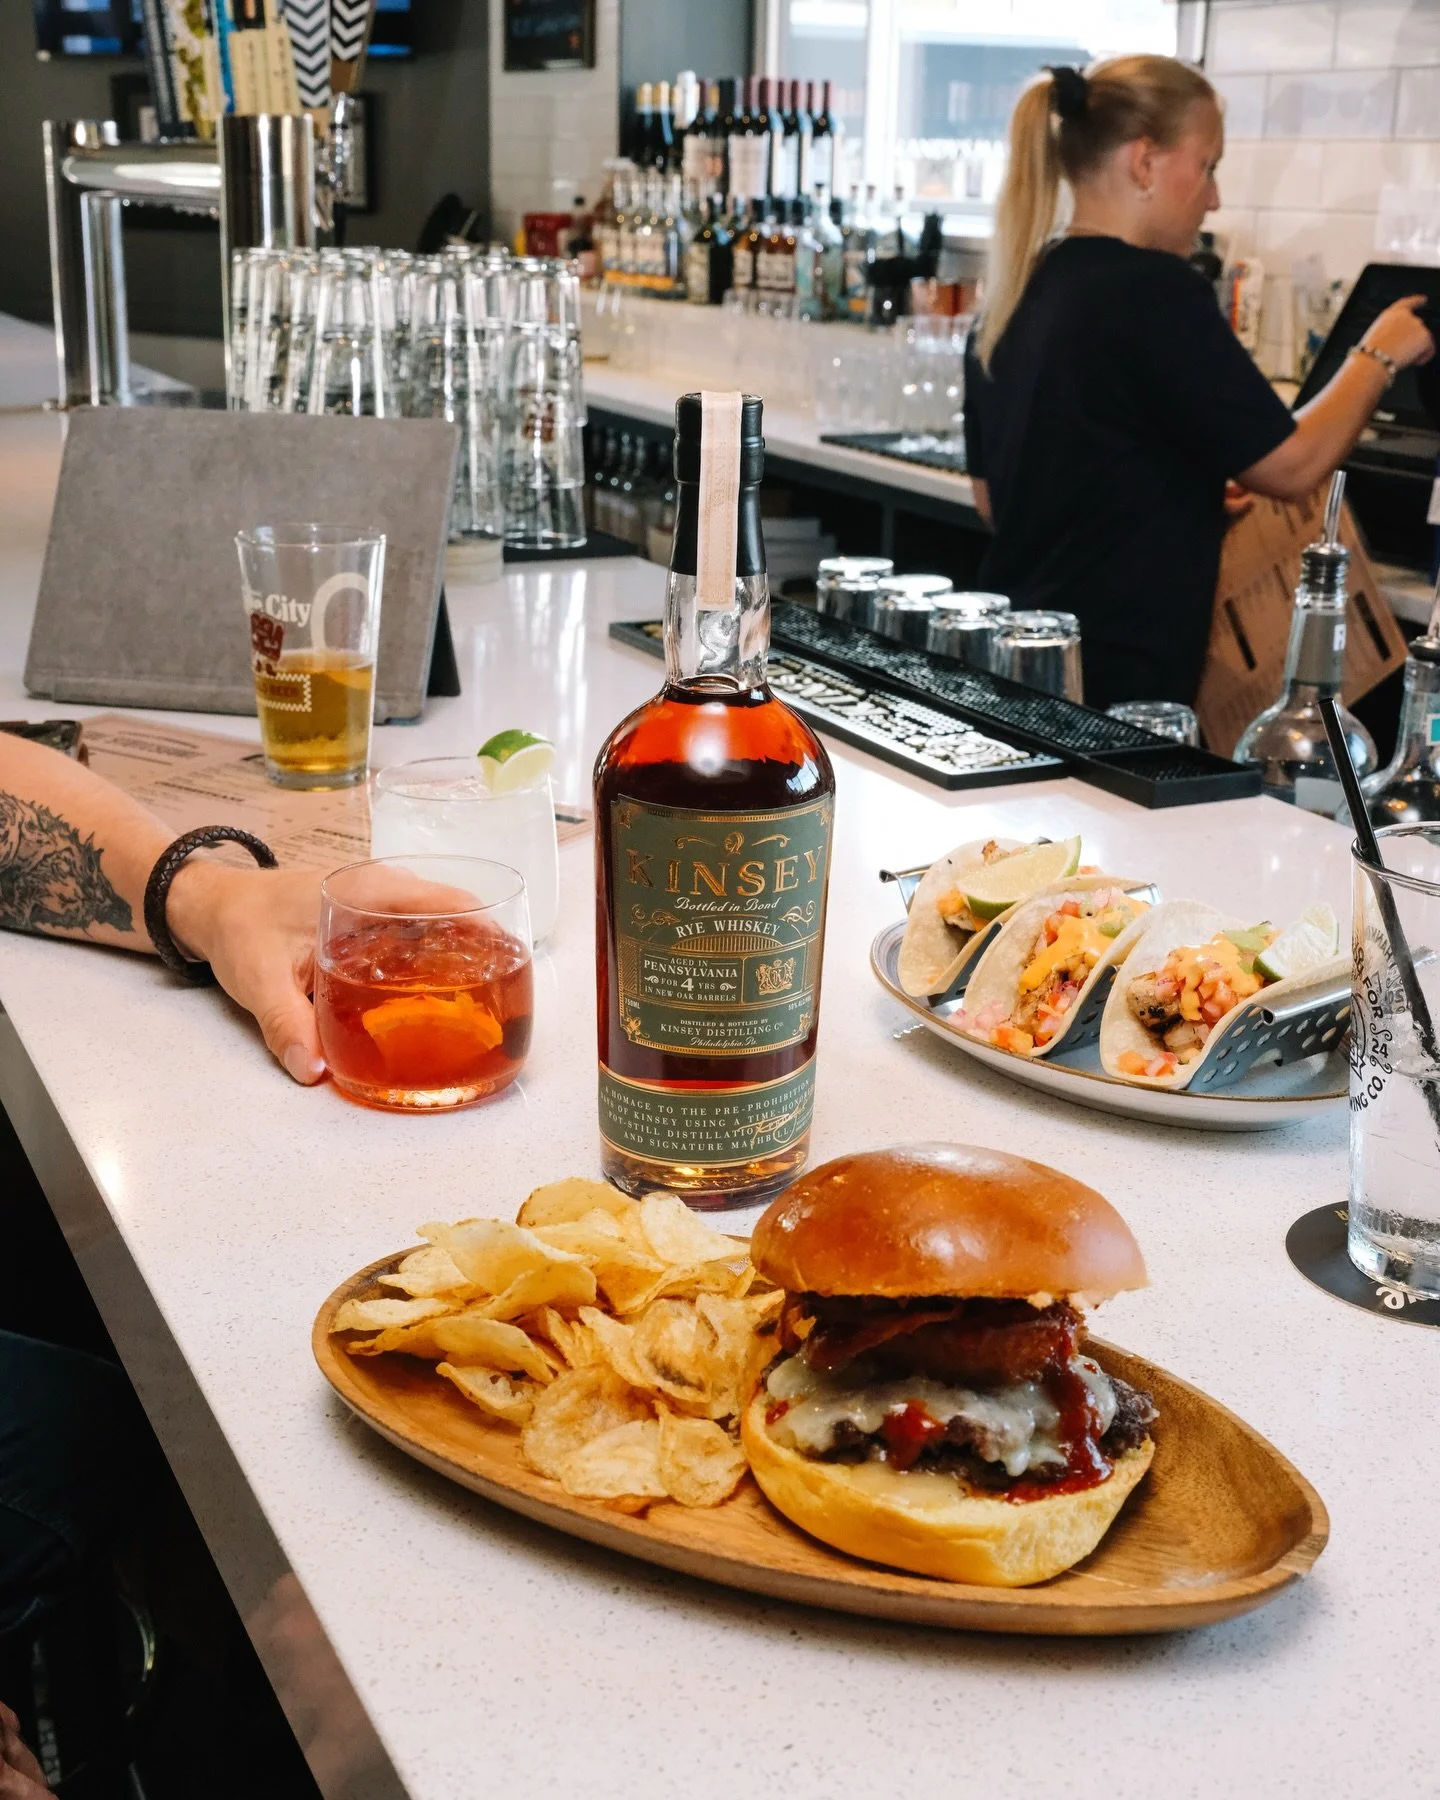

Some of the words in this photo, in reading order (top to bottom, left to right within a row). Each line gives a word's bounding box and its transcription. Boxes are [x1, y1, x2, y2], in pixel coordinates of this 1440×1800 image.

[265, 594, 311, 627] City
[626, 846, 823, 897] KINSEY
[674, 897, 729, 912] Bottled
[728, 903, 740, 912] in
[743, 897, 782, 911] Bond
[675, 922, 706, 938] RYE
[713, 920, 780, 937] WHISKEY
[644, 960, 738, 978] PENNSYLVANIA
[670, 957, 694, 966] AGED
[645, 985, 653, 993] IN
[655, 987, 674, 997] NEW
[677, 992, 694, 1000] OAK
[661, 978, 678, 987] FOR
[680, 977, 694, 992] 4
[698, 982, 715, 990] YRS
[660, 1023, 701, 1035] KINSEY
[706, 1024, 772, 1037] DISTILLING
[680, 1019, 716, 1027] DISTILLED
[1367, 1076, 1386, 1100] CO.
[611, 1090, 651, 1110] HOMAGE
[658, 1105, 674, 1114] TO
[680, 1107, 707, 1116] THE
[715, 1079, 810, 1115] PRE-PROHIBITION
[608, 1110, 660, 1136] POT-STILL
[667, 1122, 764, 1140] DISTILLATIO
[618, 1105, 628, 1115] OF
[634, 1111, 678, 1126] KINSEY
[685, 1119, 726, 1128] USING
[734, 1118, 740, 1126] A
[623, 1131, 643, 1143] AND
[649, 1138, 723, 1151] SIGNATURE
[731, 1127, 792, 1149] MASHBLL.
